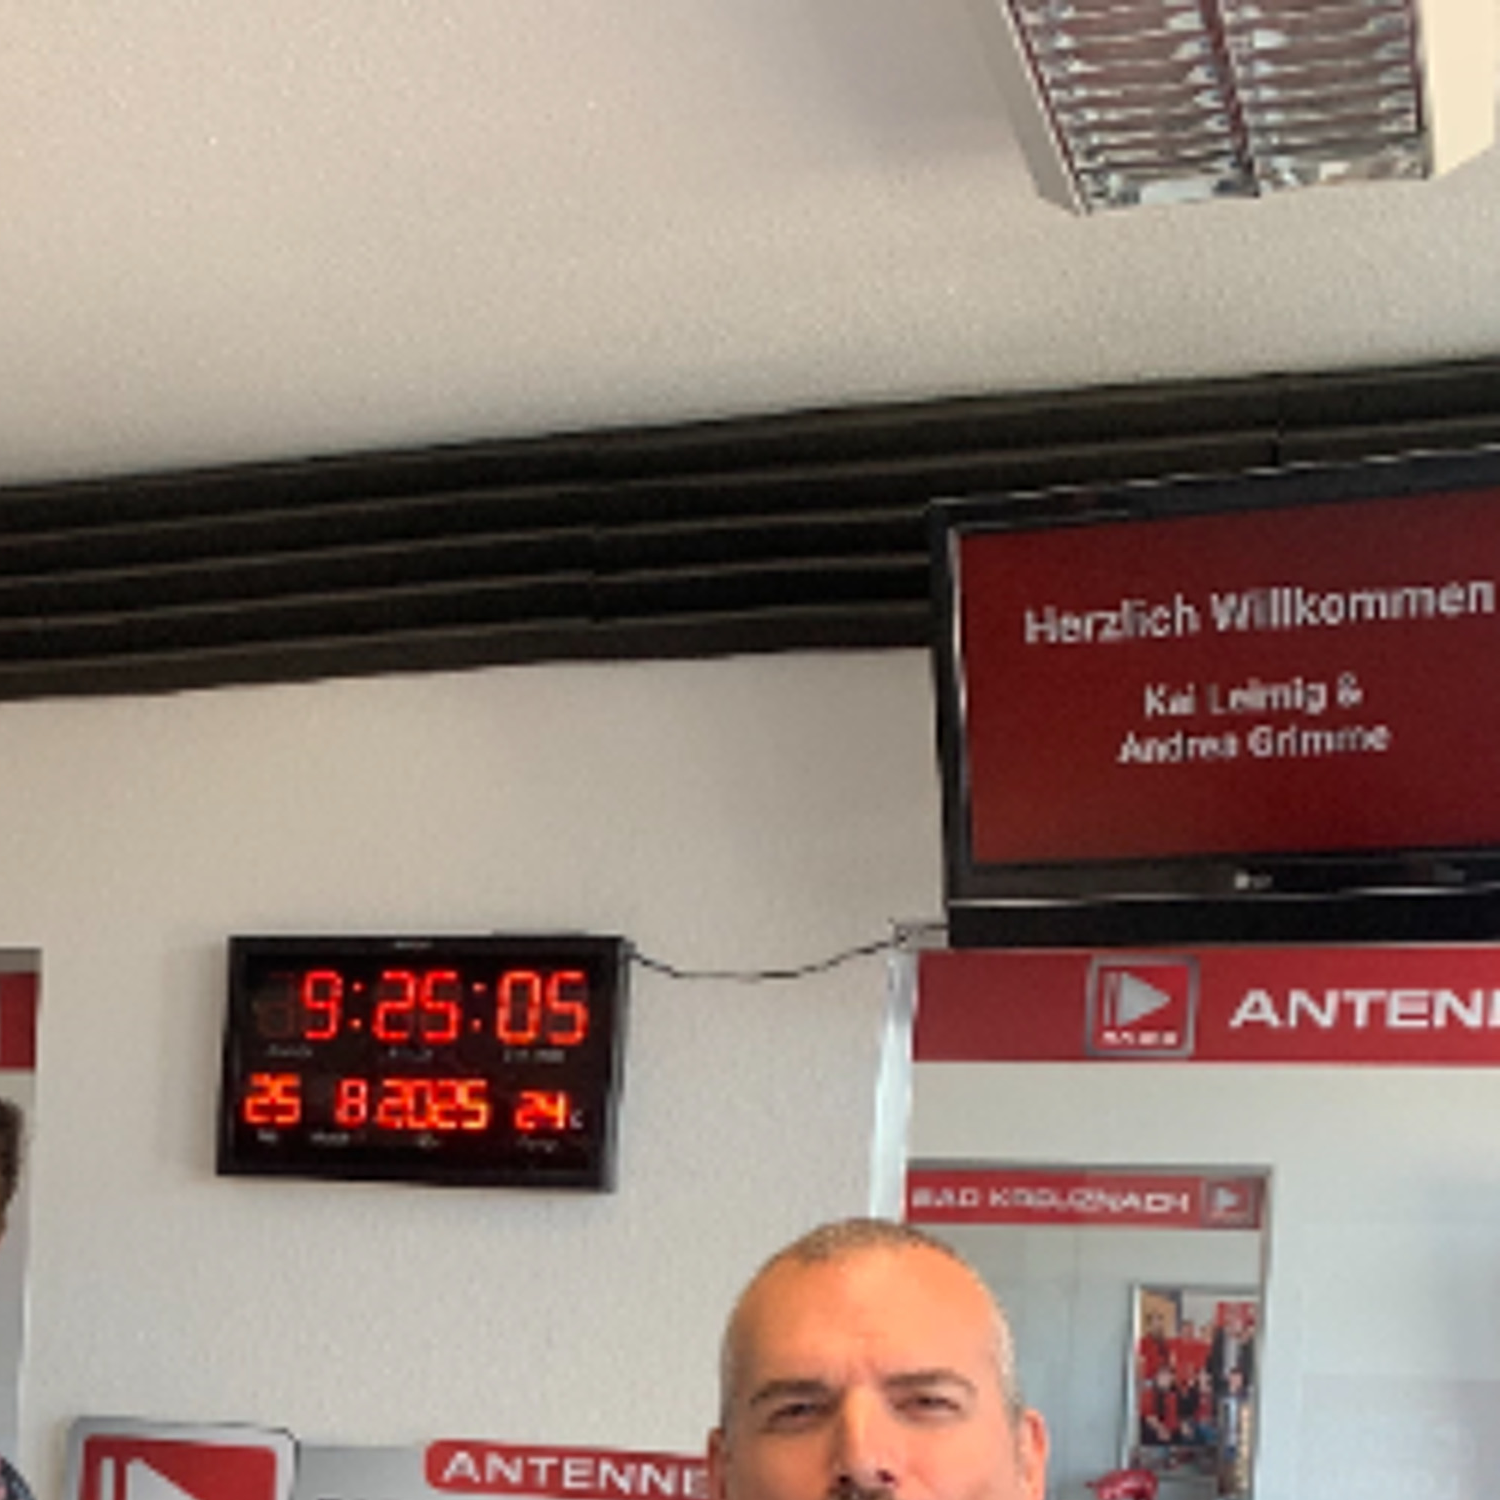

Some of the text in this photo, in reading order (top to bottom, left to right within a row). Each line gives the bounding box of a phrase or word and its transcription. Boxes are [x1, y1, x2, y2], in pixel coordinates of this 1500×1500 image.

[1023, 580, 1497, 644] Herzlich Willkommen
[1143, 684, 1196, 716] Kai
[1336, 672, 1363, 707] &
[1247, 724, 1391, 757] Grimme
[302, 969, 588, 1045] 9:25:05
[1229, 987, 1500, 1030] ANTEN
[336, 1079, 368, 1125] 8
[376, 1079, 489, 1130] 2025
